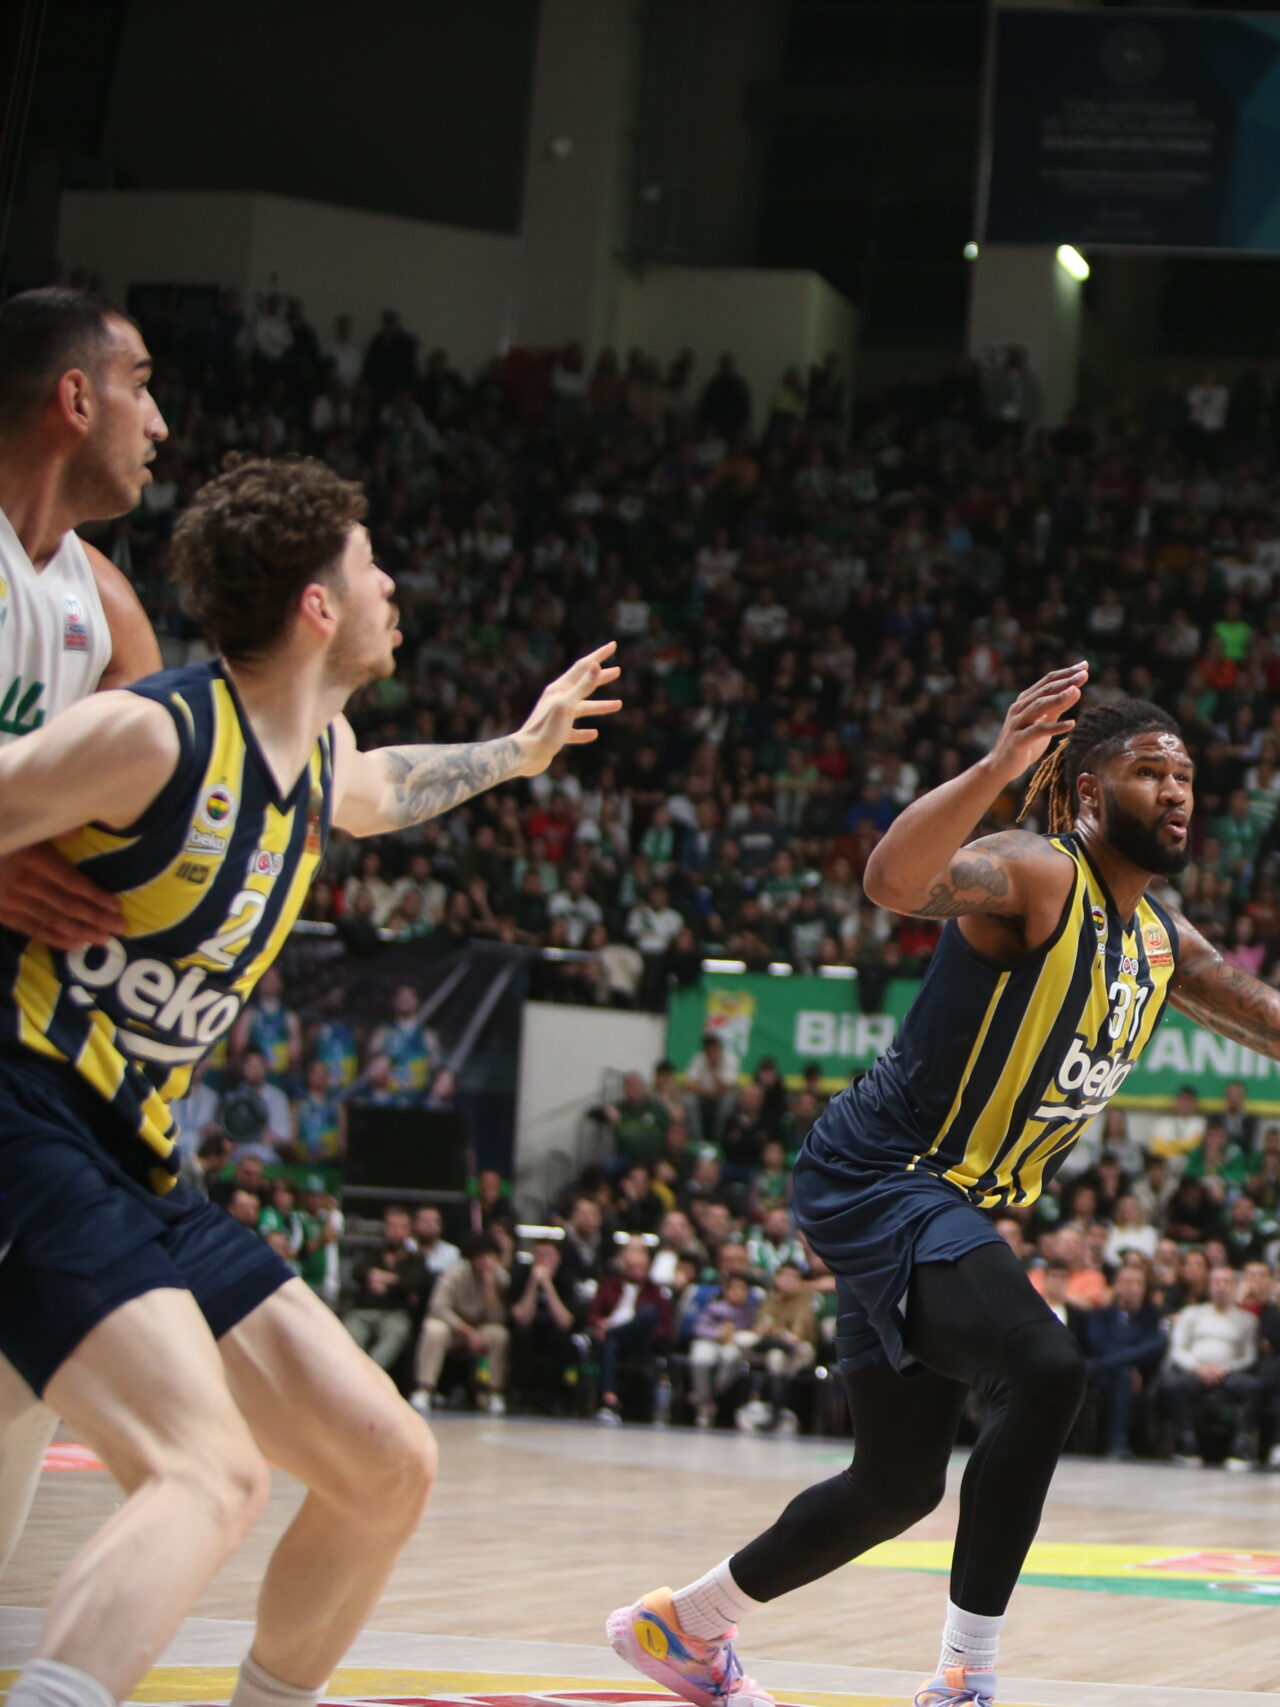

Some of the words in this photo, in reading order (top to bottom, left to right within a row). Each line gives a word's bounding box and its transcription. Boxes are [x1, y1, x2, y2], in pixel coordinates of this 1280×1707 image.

[197, 890, 268, 966] 2
[1108, 981, 1149, 1042] 31
[1058, 1037, 1132, 1098] beko
